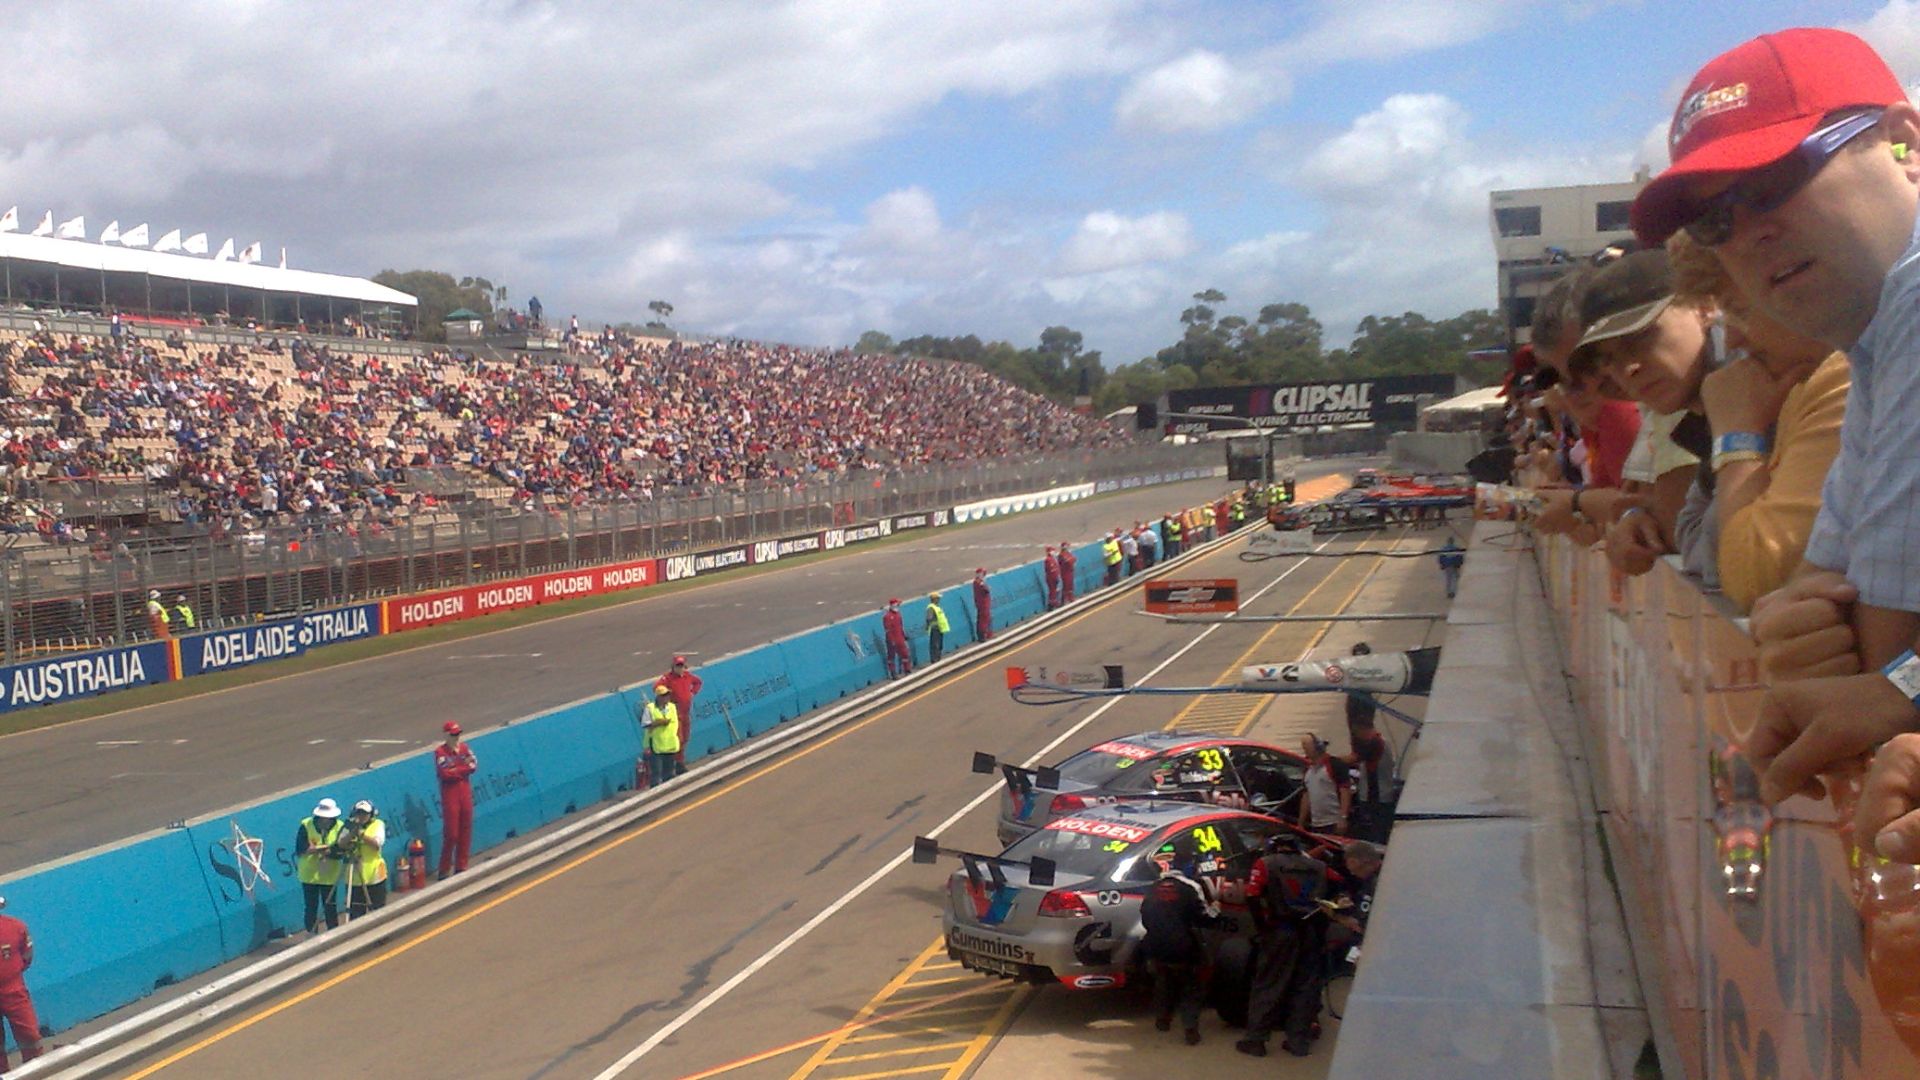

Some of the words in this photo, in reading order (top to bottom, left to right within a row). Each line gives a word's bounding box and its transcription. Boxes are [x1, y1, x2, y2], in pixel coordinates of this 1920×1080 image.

[1273, 383, 1374, 414] CLIPSAL
[1250, 415, 1289, 426] LIVING
[1296, 411, 1371, 424] ELECTRICAL
[755, 540, 778, 563] CLIPSAL
[794, 537, 819, 552] ELECTRICAL
[825, 529, 845, 550] CLIPSAL
[666, 555, 696, 581] CLIPSAL
[696, 555, 715, 571] LIVING
[715, 549, 747, 568] ELECTRICAL
[401, 596, 464, 623] HOLDEN
[478, 585, 532, 609] HOLDEN
[544, 576, 592, 596] HOLDEN
[603, 567, 646, 587] HOLDEN
[202, 624, 297, 668] ADELAIDE
[12, 649, 146, 704] AUSTRALIA
[1199, 749, 1224, 771] 33
[1055, 818, 1144, 840] HOLDEN
[1193, 825, 1222, 852] 34
[1103, 840, 1130, 853] 34
[951, 926, 1024, 959] Cummins
